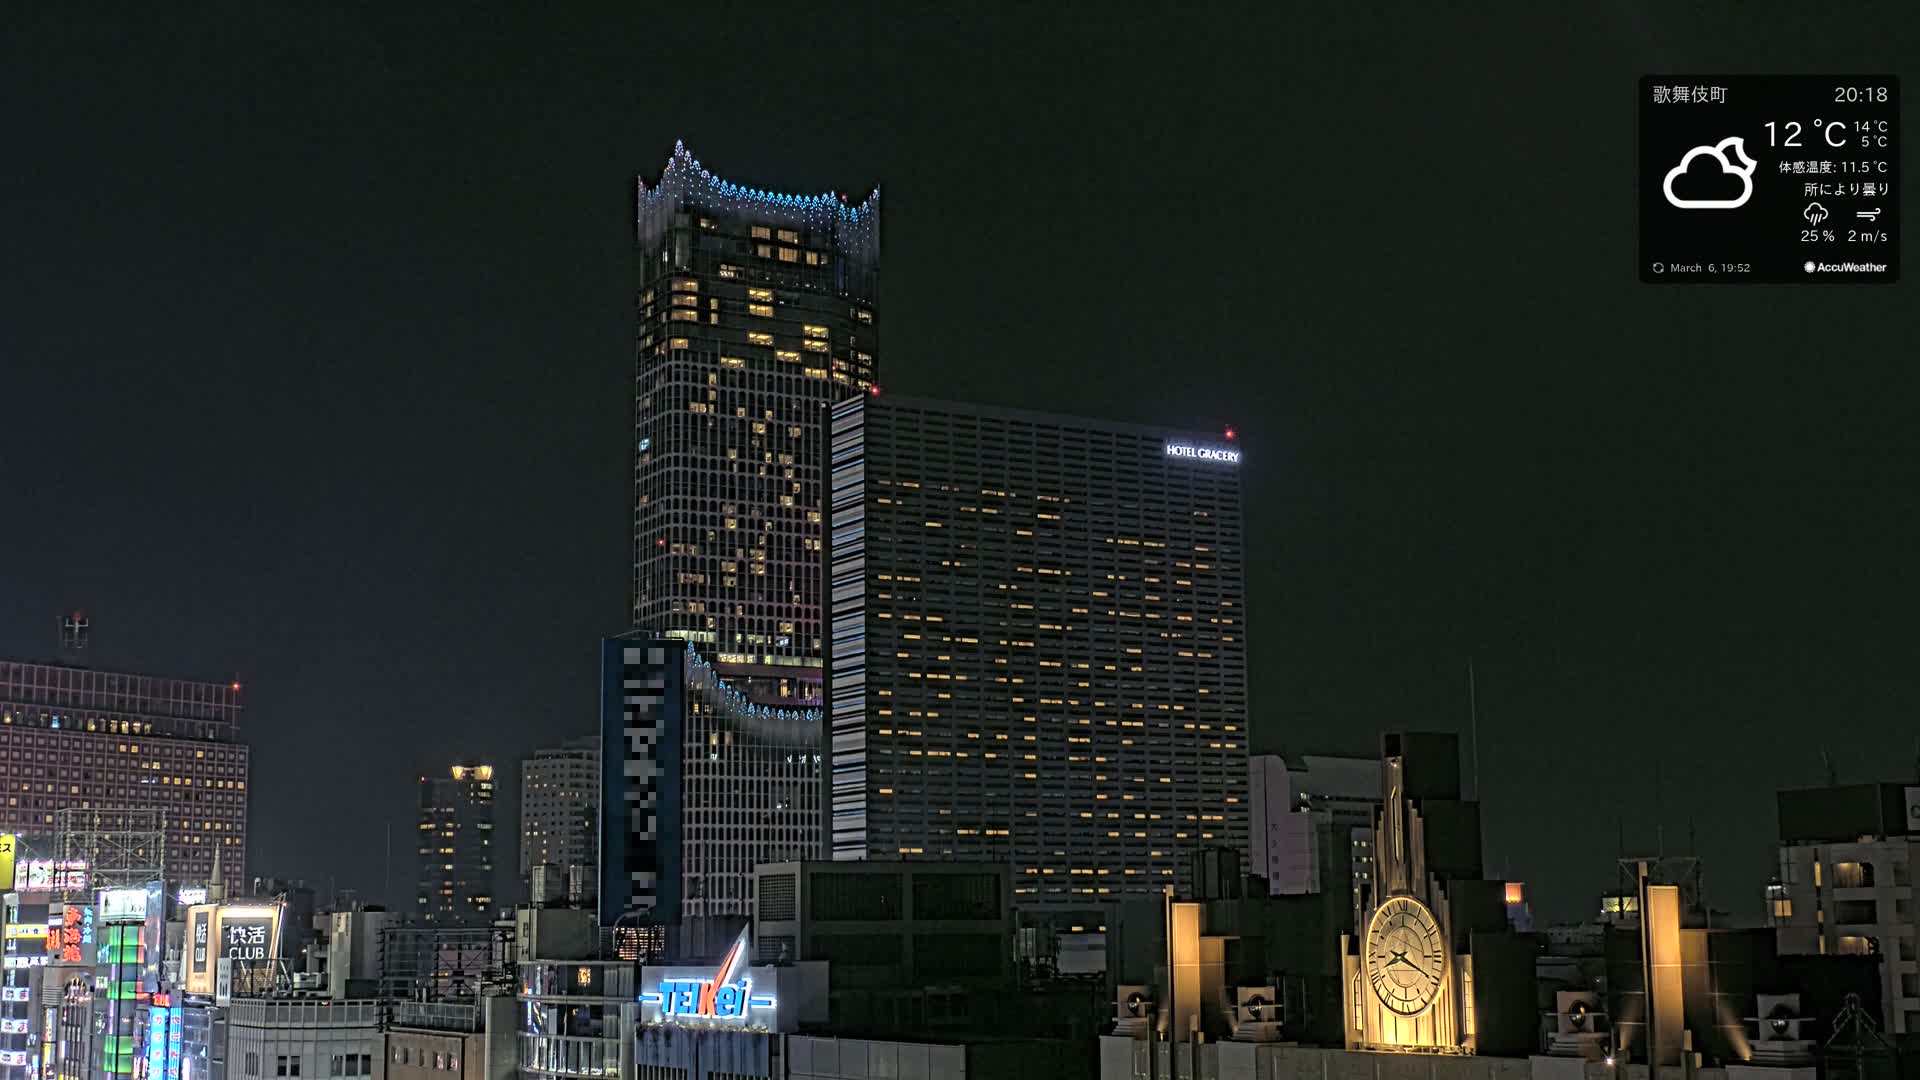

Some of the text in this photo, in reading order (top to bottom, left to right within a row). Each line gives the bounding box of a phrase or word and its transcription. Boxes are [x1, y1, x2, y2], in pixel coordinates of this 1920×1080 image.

[1166, 444, 1239, 462] HOTEL GRACERY
[229, 925, 266, 945] 快活
[229, 947, 265, 960] CLUB
